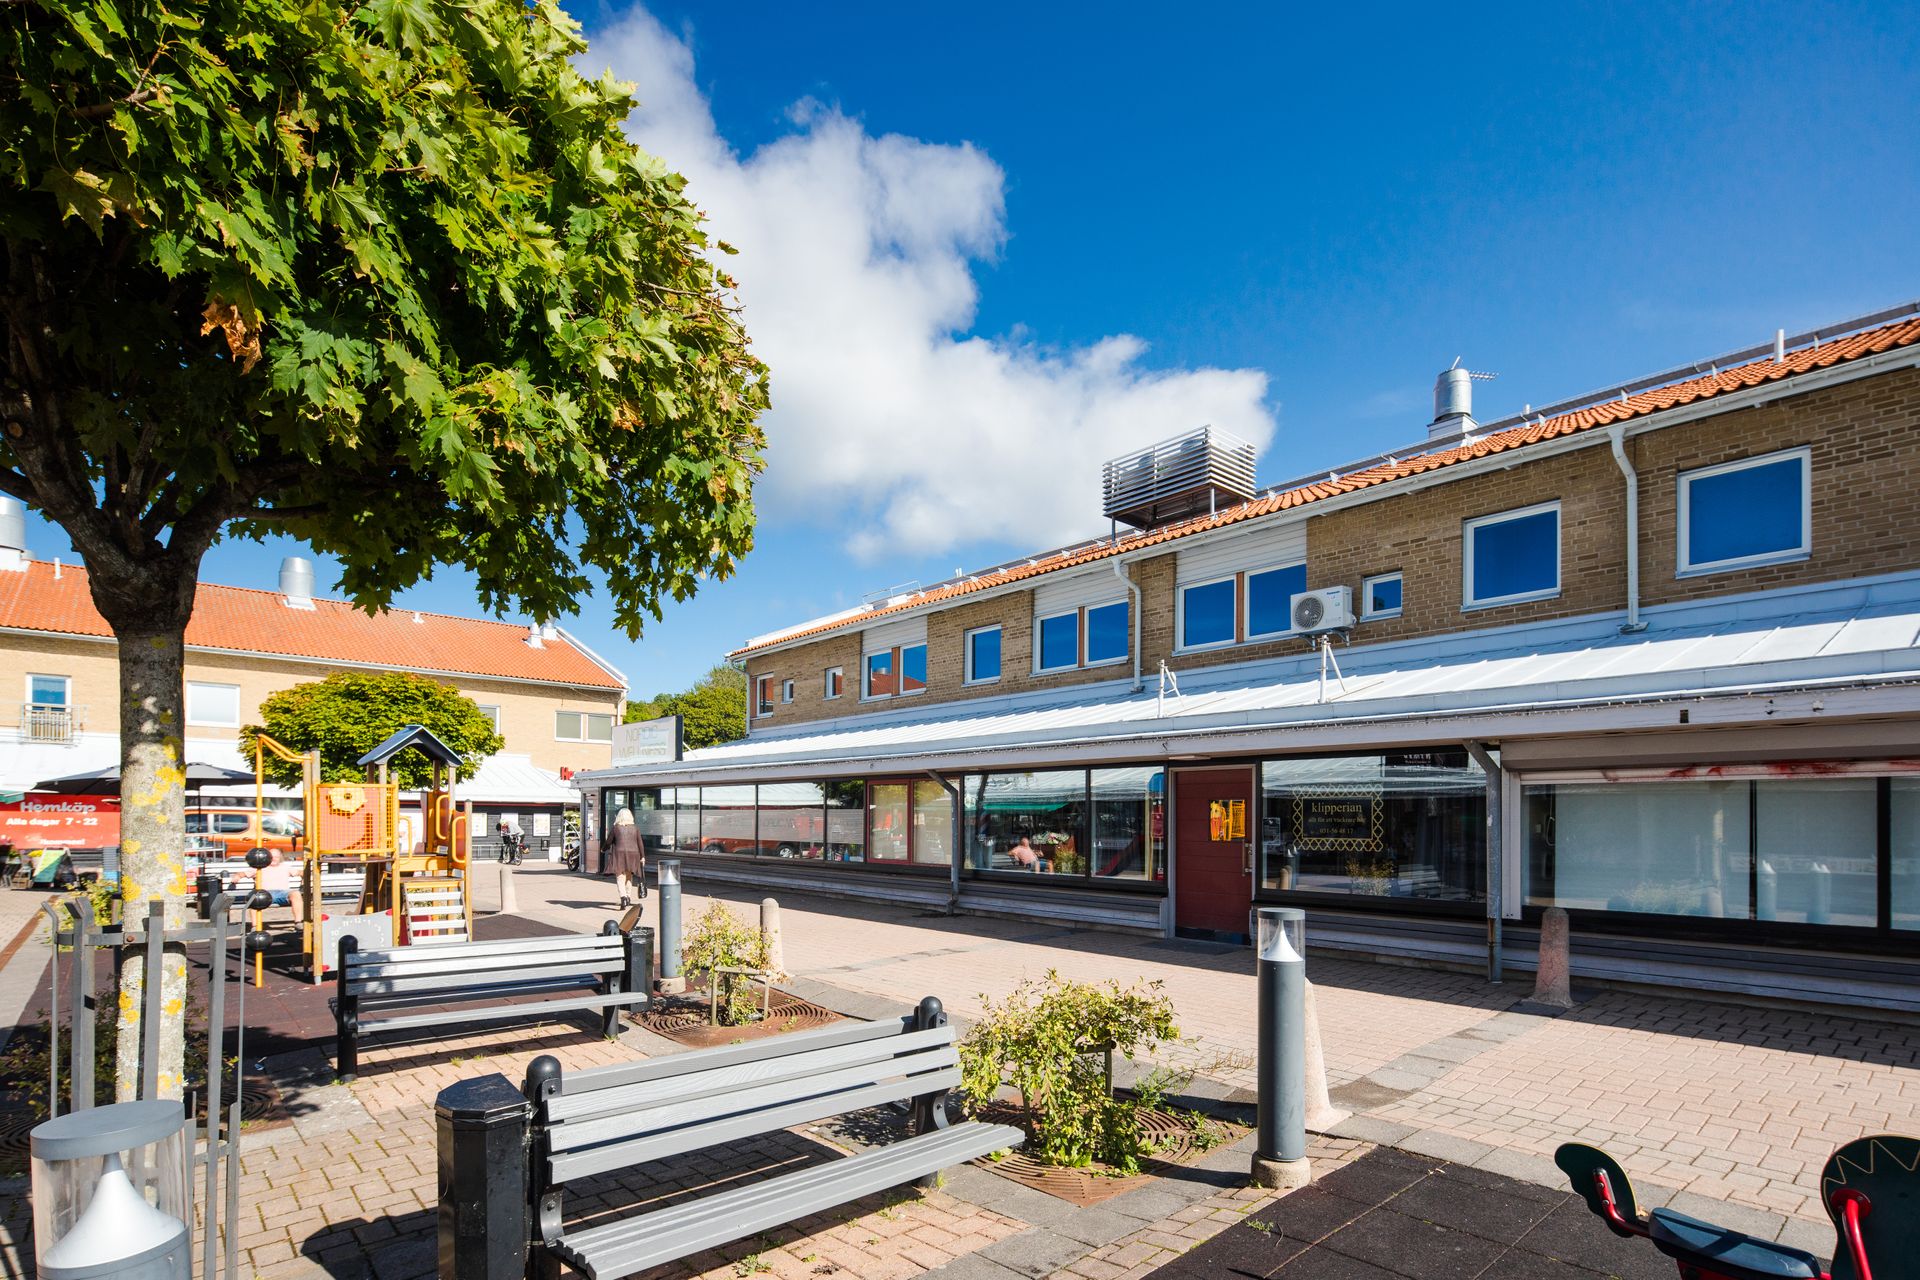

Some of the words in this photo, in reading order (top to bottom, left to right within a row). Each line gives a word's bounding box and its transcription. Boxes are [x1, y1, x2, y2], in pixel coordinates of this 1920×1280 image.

[19, 802, 97, 814] Hemköp
[1312, 802, 1363, 815] klipperian
[29, 817, 61, 827] dagar
[65, 817, 74, 826] 7
[82, 817, 98, 826] 22
